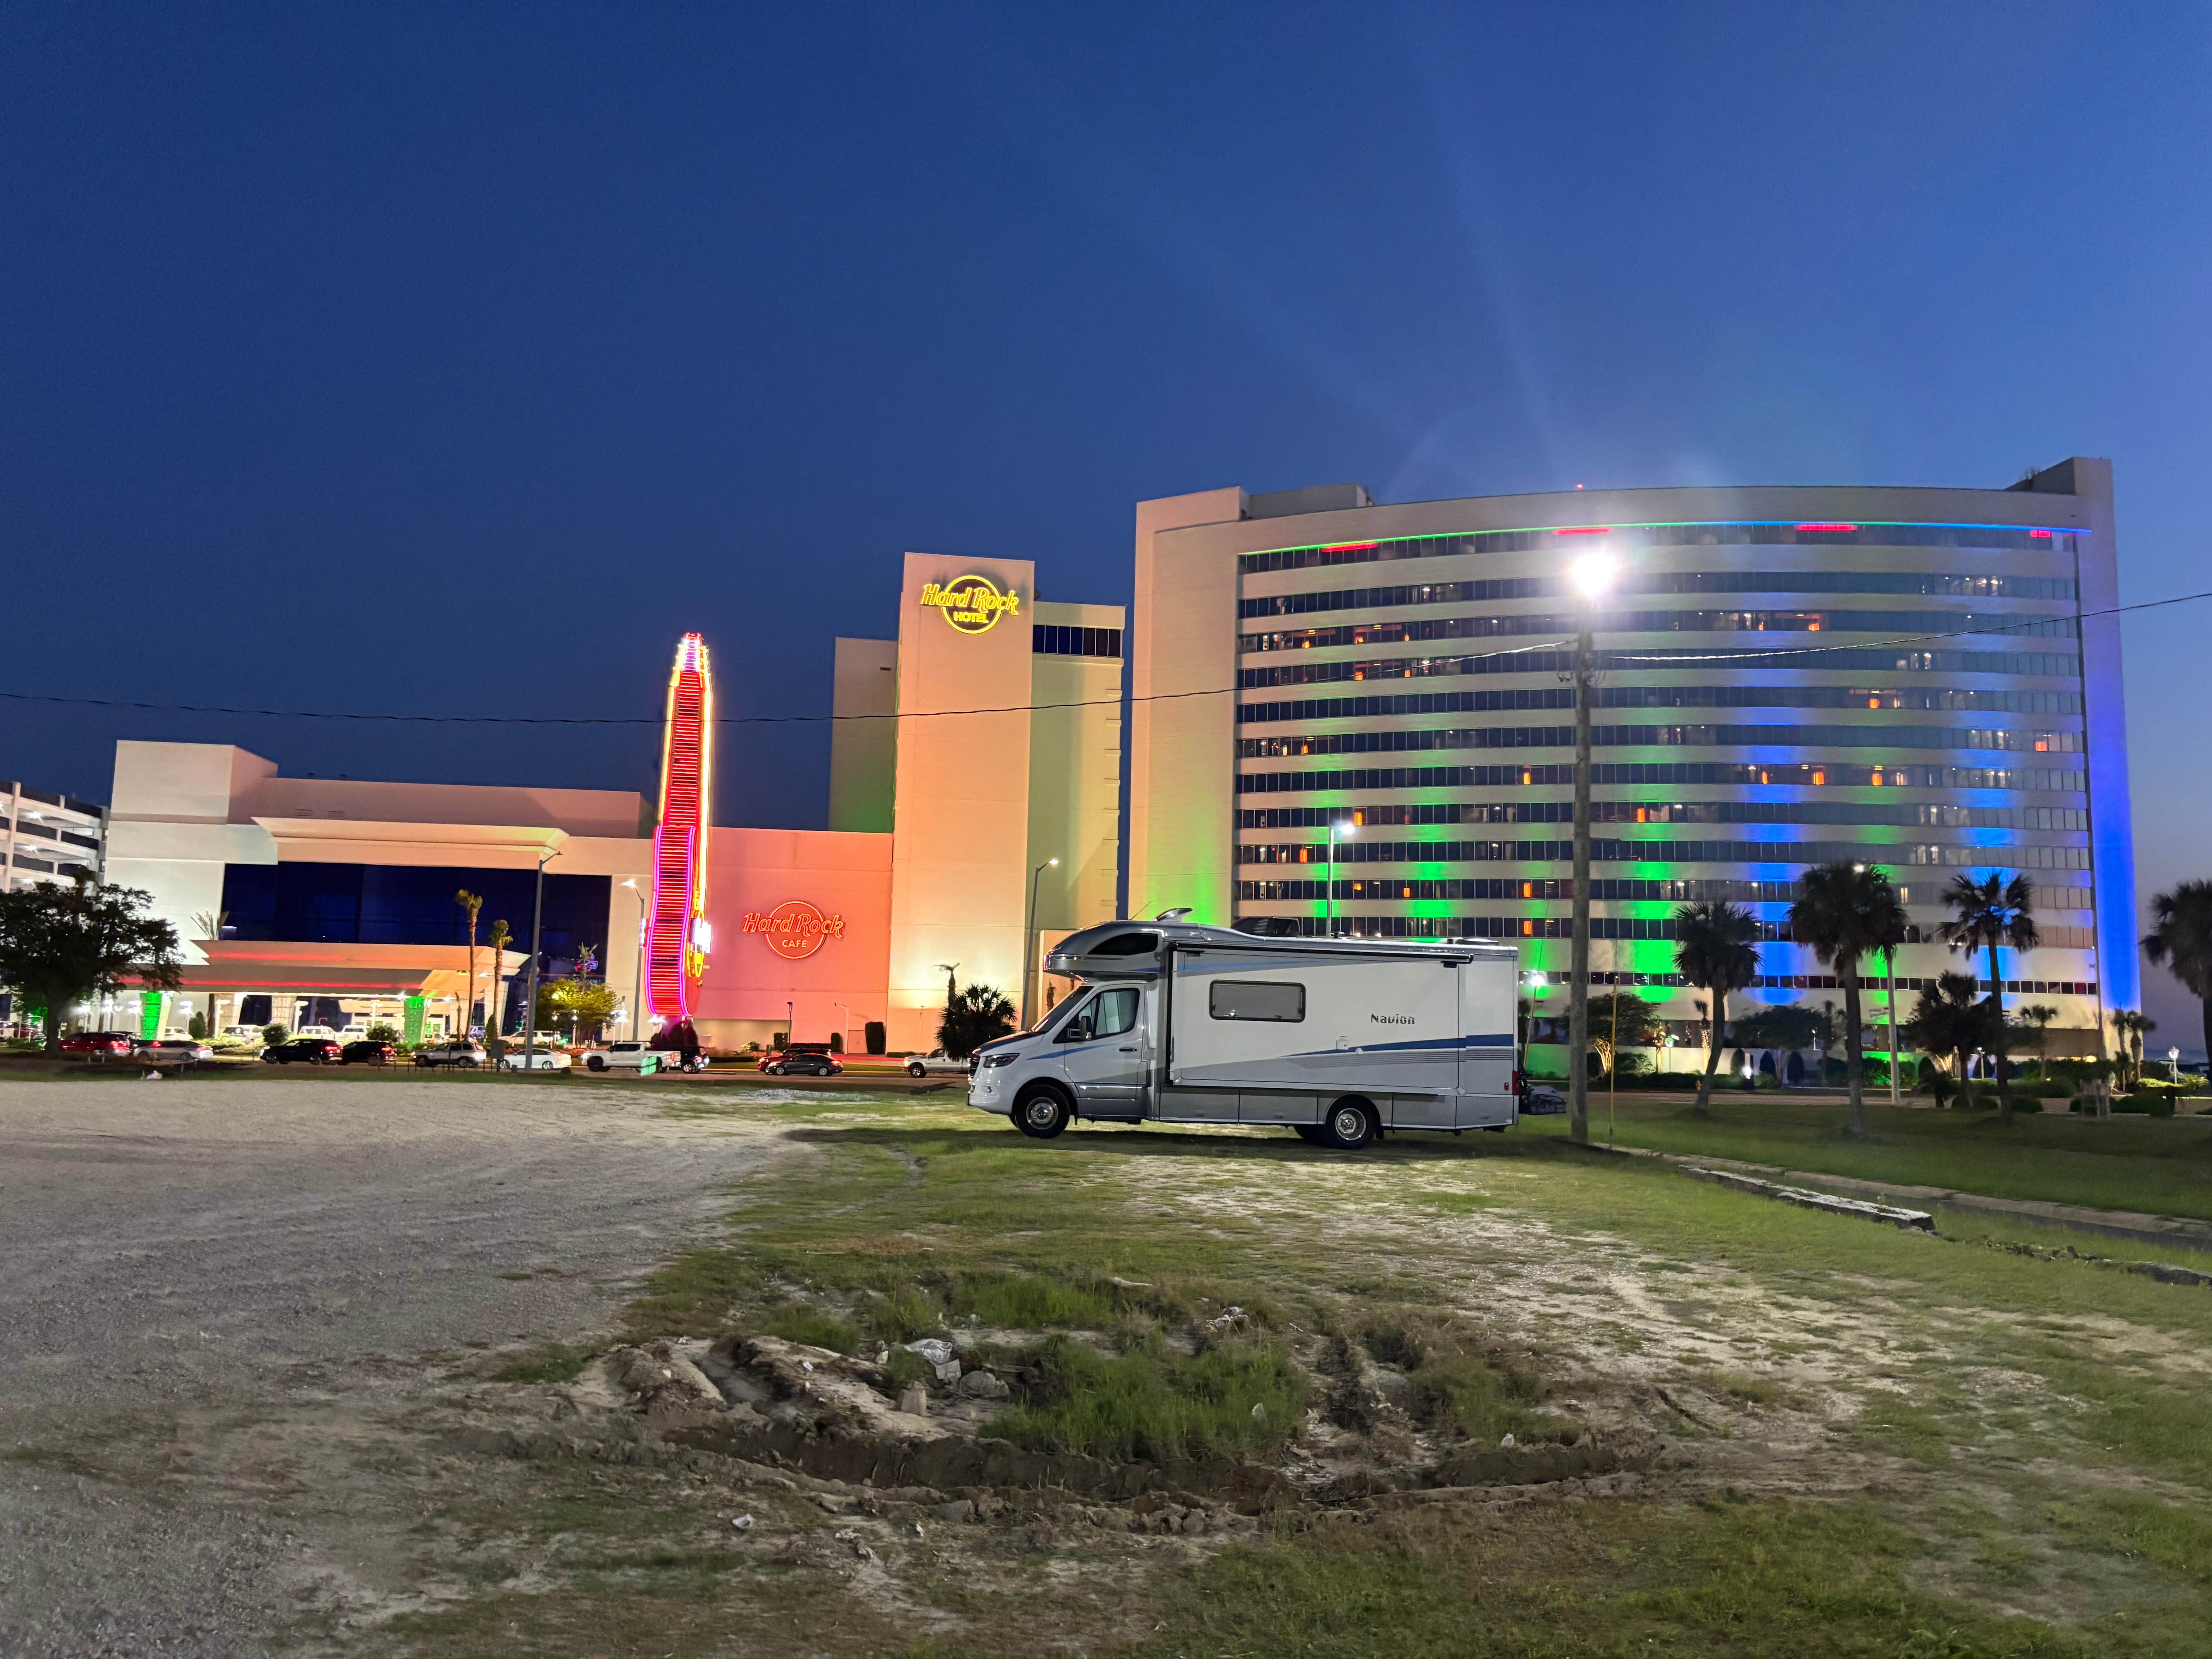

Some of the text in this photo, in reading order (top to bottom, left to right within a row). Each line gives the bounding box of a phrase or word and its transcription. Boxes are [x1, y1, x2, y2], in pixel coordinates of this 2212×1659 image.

[921, 584, 1019, 616] Hard Rock
[954, 611, 989, 623] HOTEL
[743, 913, 843, 938] Hard Rock
[782, 939, 808, 948] CAFE
[1371, 1013, 1415, 1024] Navion
